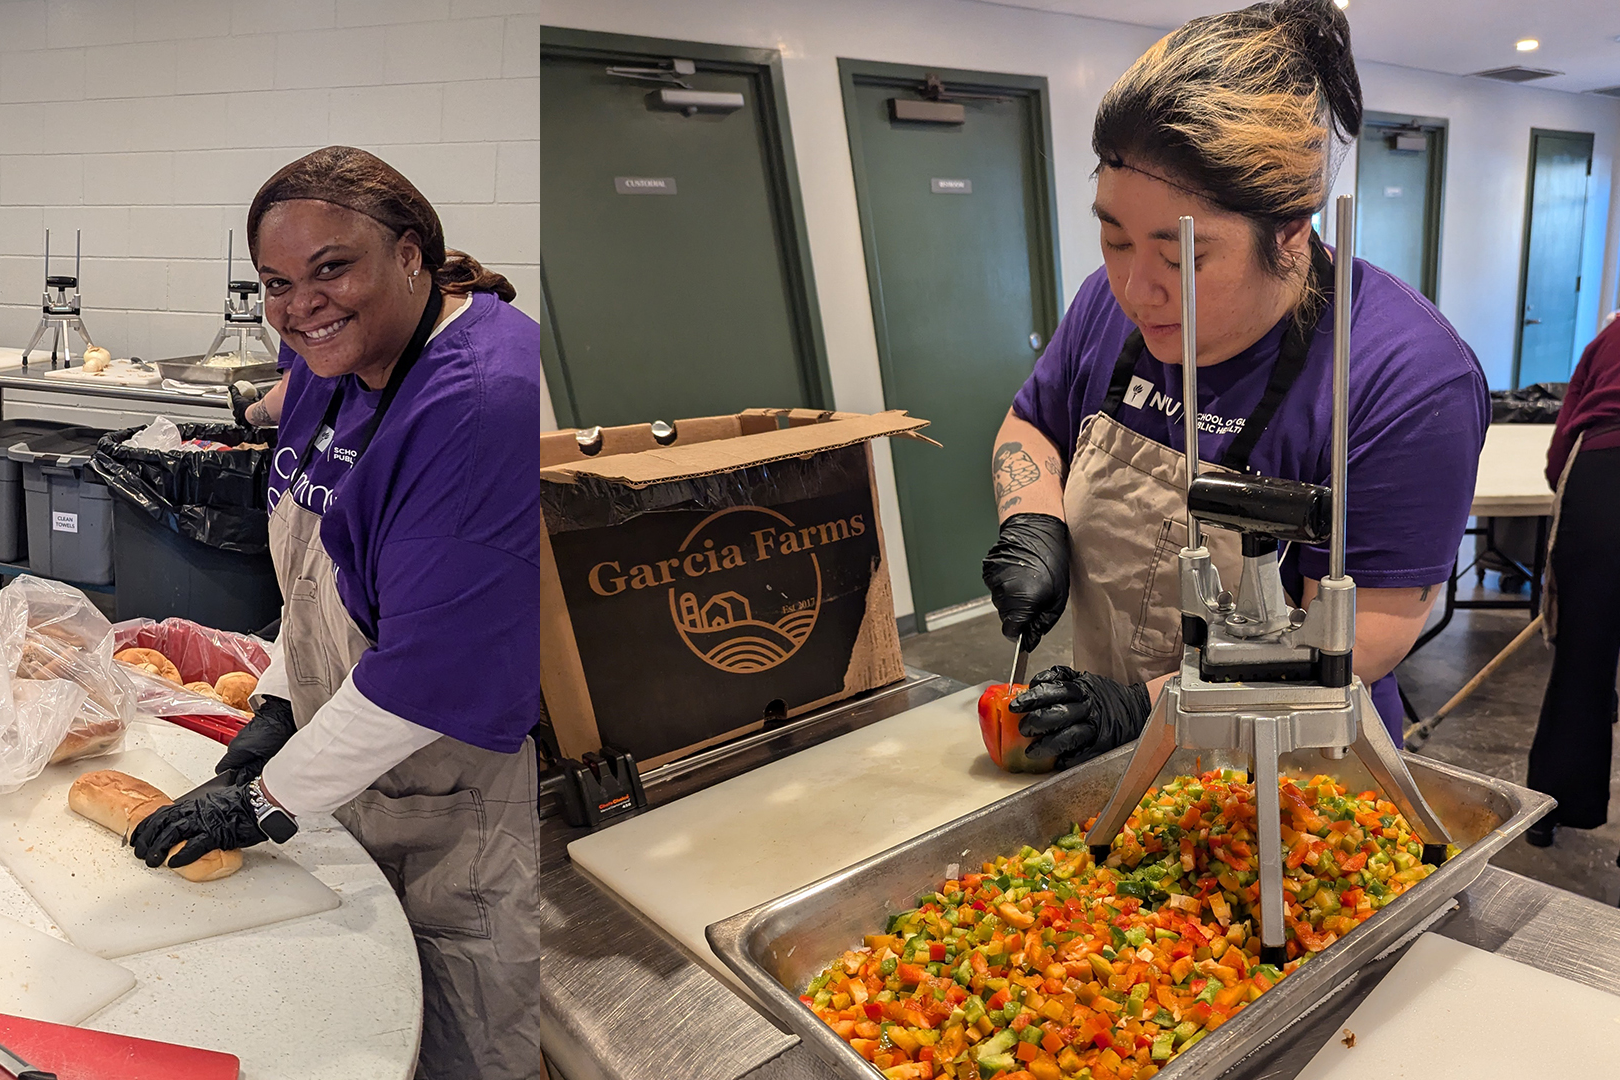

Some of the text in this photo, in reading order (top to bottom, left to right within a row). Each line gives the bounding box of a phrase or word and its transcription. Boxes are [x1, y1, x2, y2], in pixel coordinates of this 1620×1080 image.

[1149, 391, 1182, 417] NU
[1197, 412, 1224, 426] CHOOL
[1197, 422, 1216, 434] BLIC
[333, 446, 358, 457] SCHO
[55, 521, 75, 529] TOWELS
[57, 515, 74, 523] CLEAN
[588, 513, 866, 597] Garcia Farms
[782, 598, 816, 614] Est 2017
